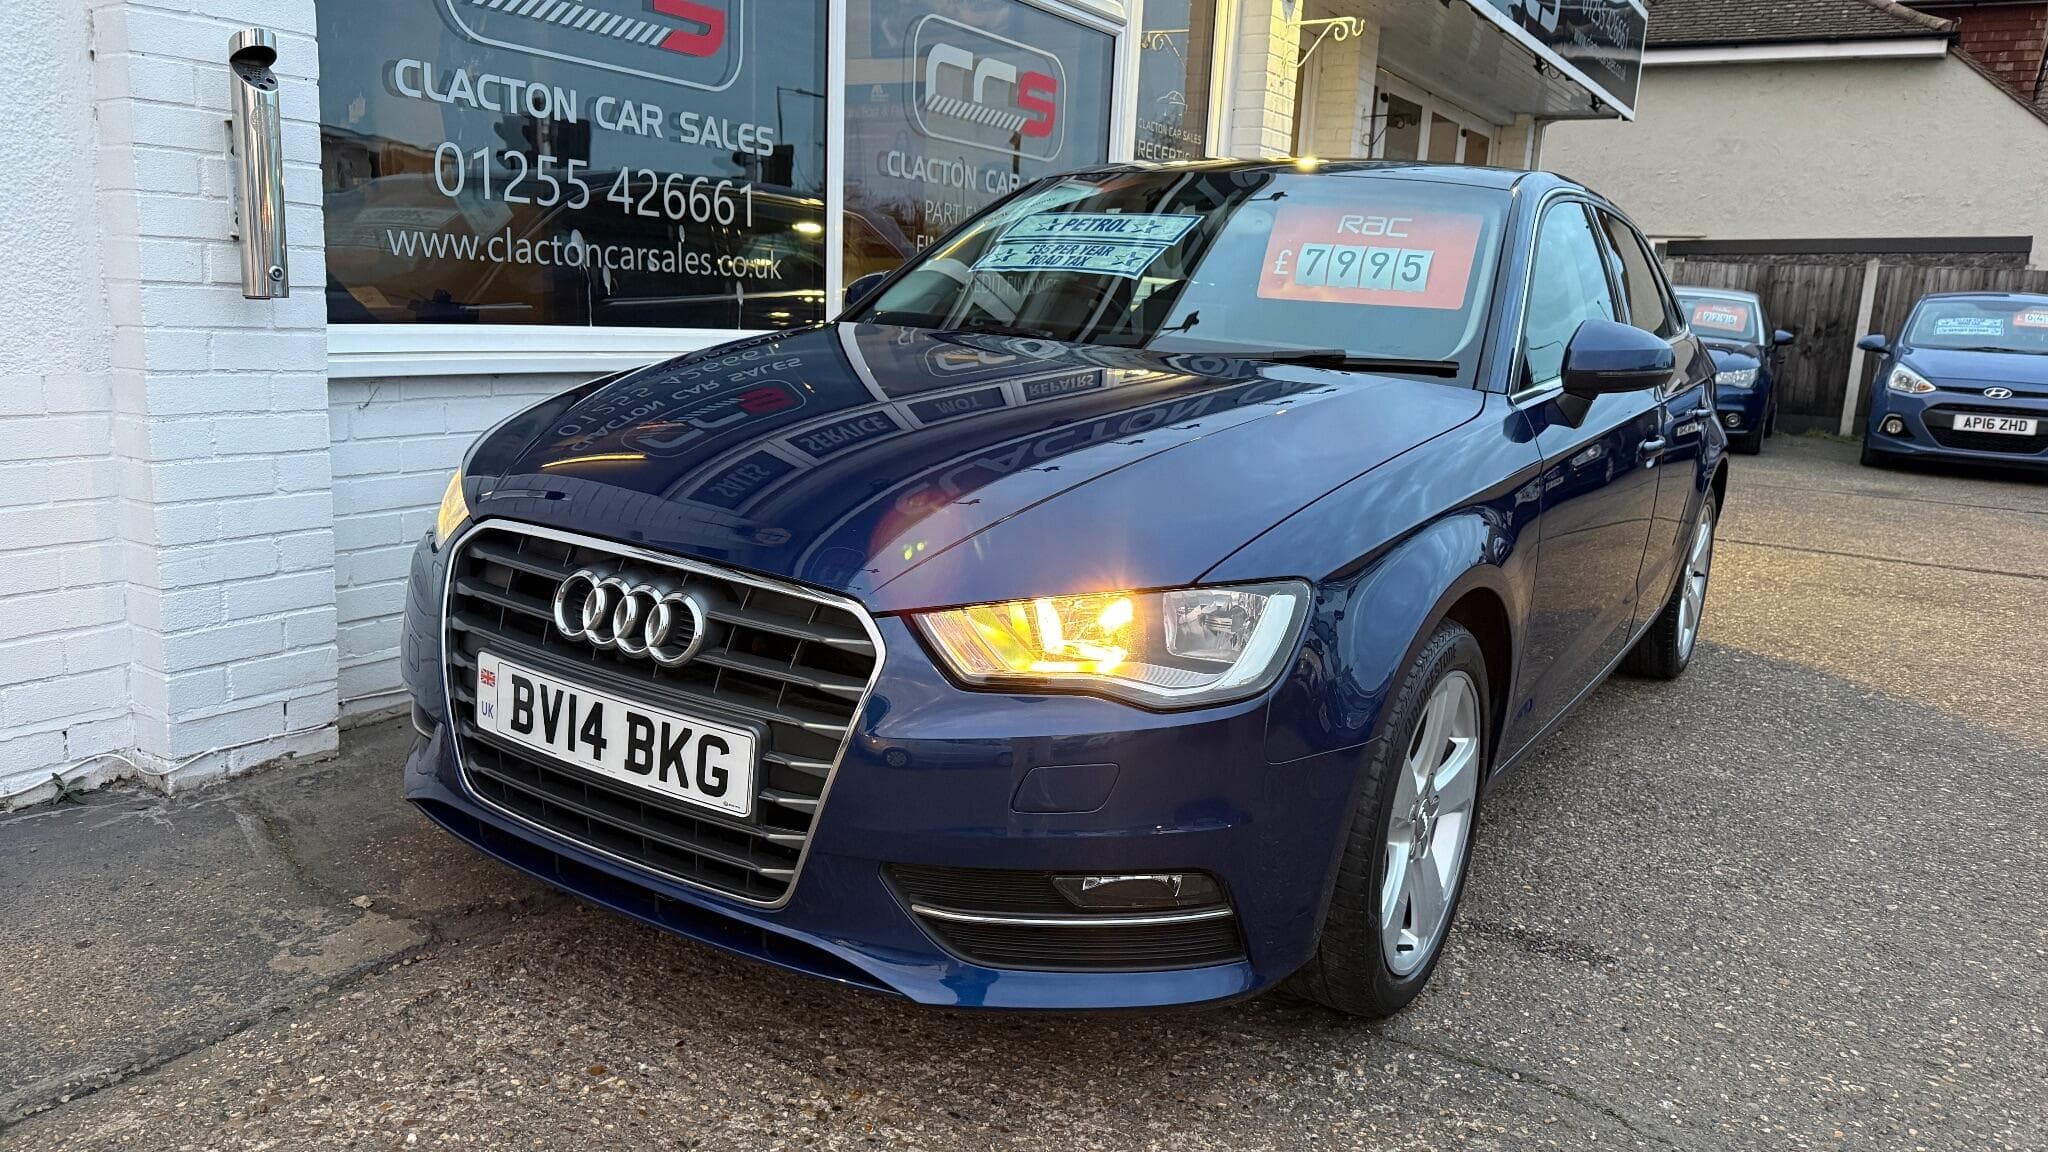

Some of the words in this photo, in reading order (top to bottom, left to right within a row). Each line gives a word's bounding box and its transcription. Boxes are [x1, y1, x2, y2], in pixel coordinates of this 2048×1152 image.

[925, 43, 1056, 138] CCS
[395, 58, 577, 124] CLACTON
[596, 95, 663, 138] CAR
[679, 111, 774, 157] SALES
[1137, 118, 1168, 135] CLACTON
[1168, 127, 1182, 139] CAR
[1183, 131, 1202, 145] SALES
[434, 141, 589, 210] 01255
[607, 166, 753, 228] 426661
[887, 150, 977, 193] CLACTON
[985, 169, 1020, 195] CAR
[925, 199, 960, 225] PART
[1060, 218, 1131, 233] PETROL
[386, 226, 782, 281] www.clactoncarsales.co.uk
[1027, 244, 1052, 255] £35
[1051, 244, 1080, 255] PER
[1079, 245, 1116, 257] YEAR
[1027, 254, 1062, 266] ROAD
[1062, 256, 1092, 267] TAX
[1963, 417, 1995, 430] AP16
[1998, 418, 2028, 432] ZHD
[481, 701, 494, 720] UK
[510, 673, 608, 761] BV14
[623, 710, 730, 798] BKG
